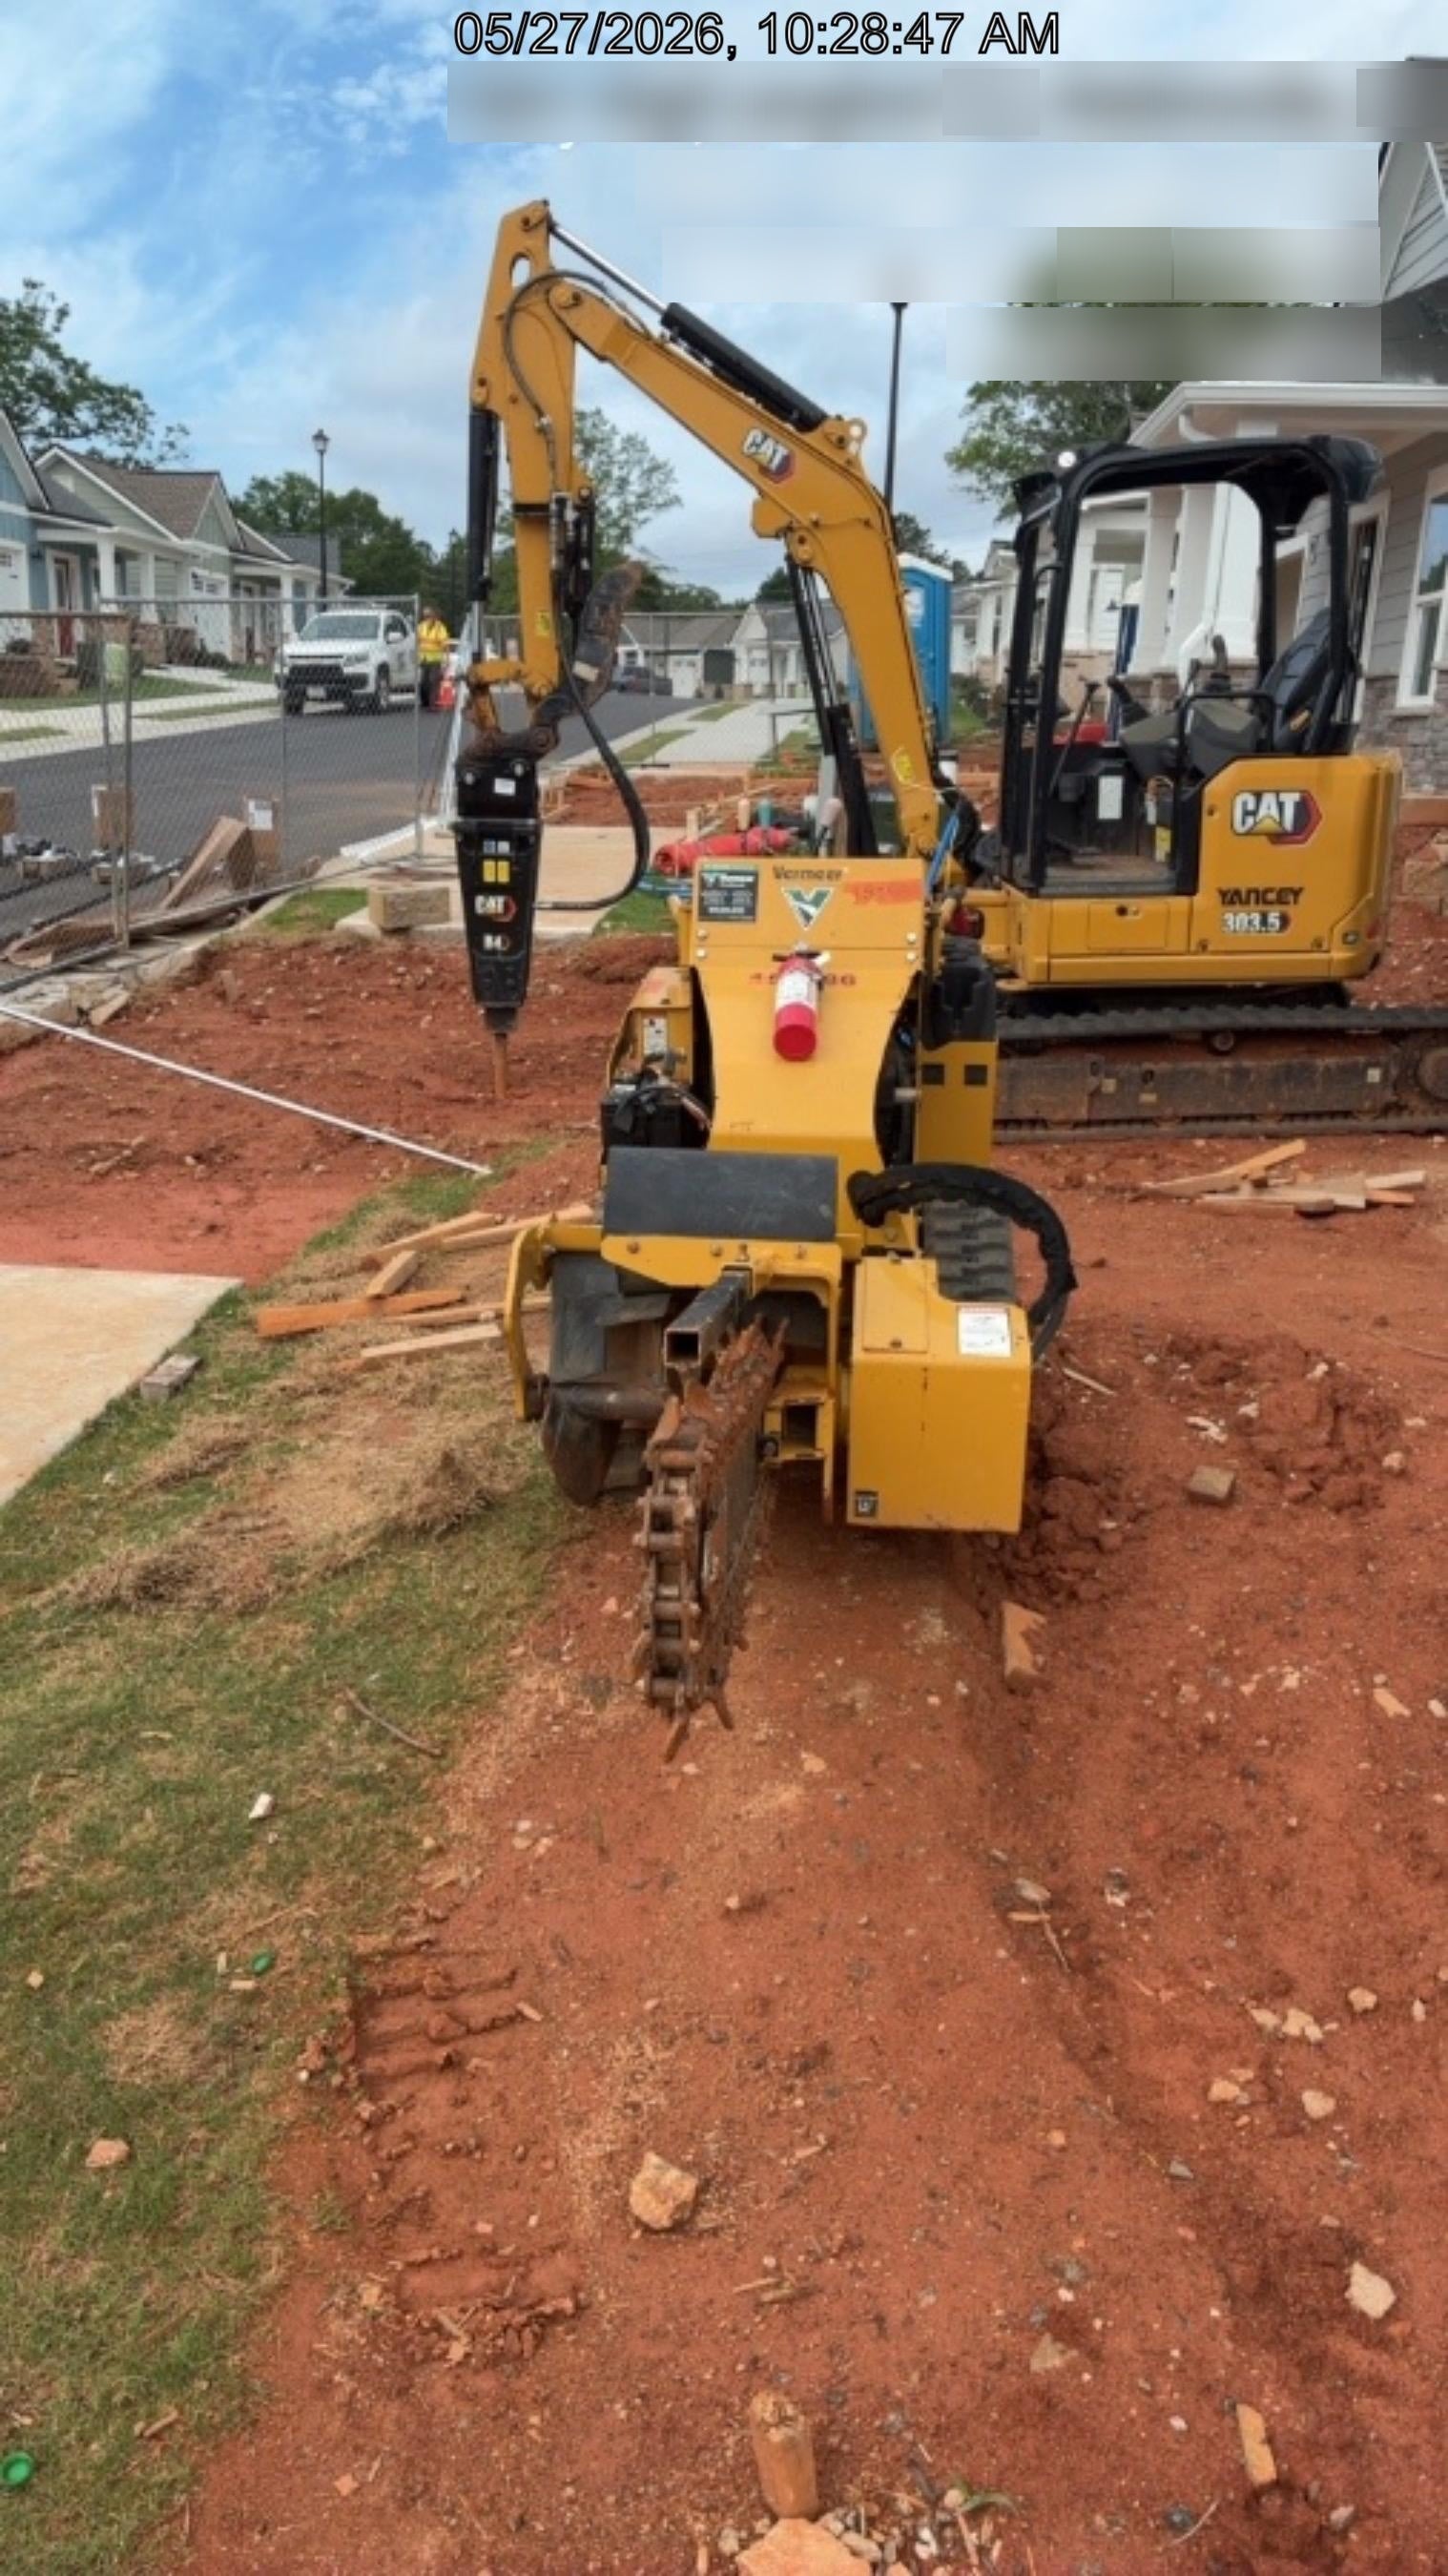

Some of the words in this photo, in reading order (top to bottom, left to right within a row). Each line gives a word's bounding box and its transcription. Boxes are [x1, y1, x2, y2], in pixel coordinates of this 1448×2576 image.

[742, 427, 790, 471] CAT
[1233, 792, 1301, 834] CAT
[474, 895, 506, 915] CAT
[1217, 886, 1304, 905] YANCEY
[1221, 911, 1281, 933] 303.5
